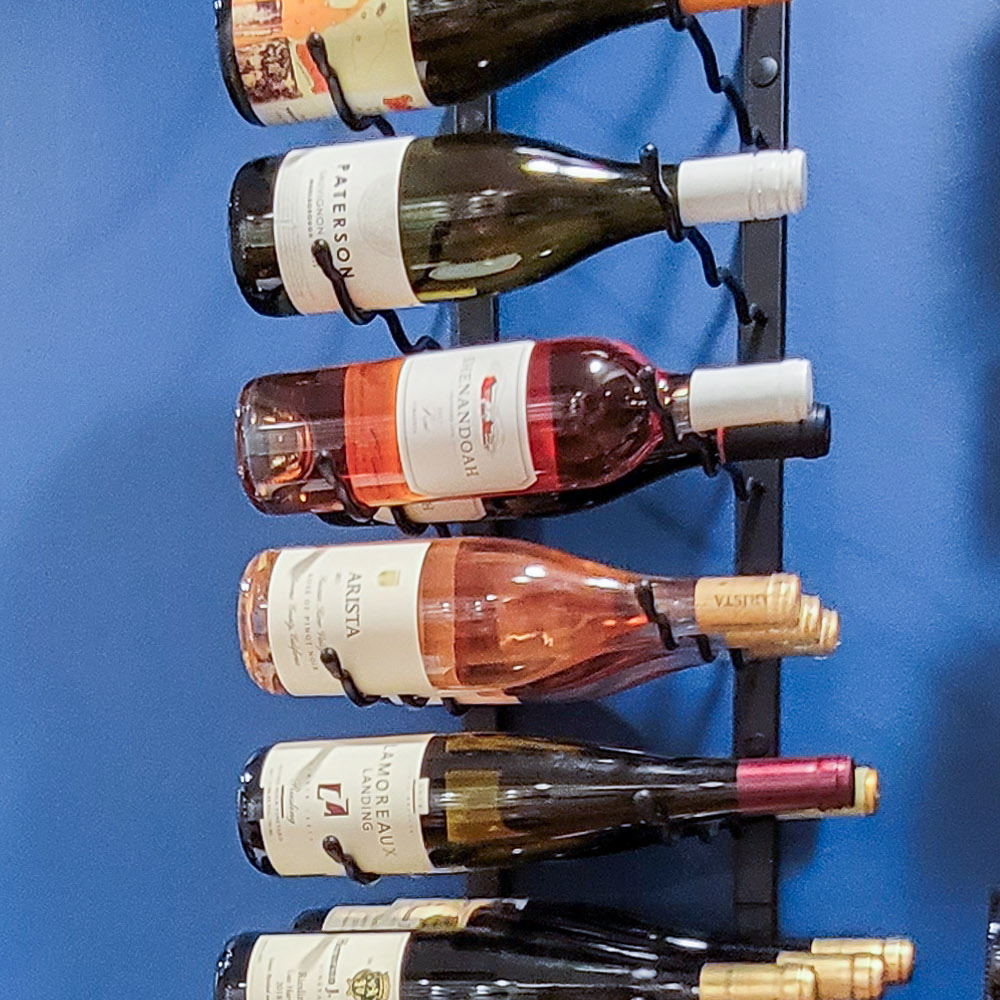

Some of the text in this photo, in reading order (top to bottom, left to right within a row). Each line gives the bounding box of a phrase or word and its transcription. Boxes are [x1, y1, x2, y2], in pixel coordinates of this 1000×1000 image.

[331, 163, 355, 279] PATERSON
[457, 356, 480, 478] SHENANDOAH
[345, 570, 363, 639] ARISTA
[360, 768, 374, 832] LANDING
[374, 743, 398, 857] LAMOREAUX
